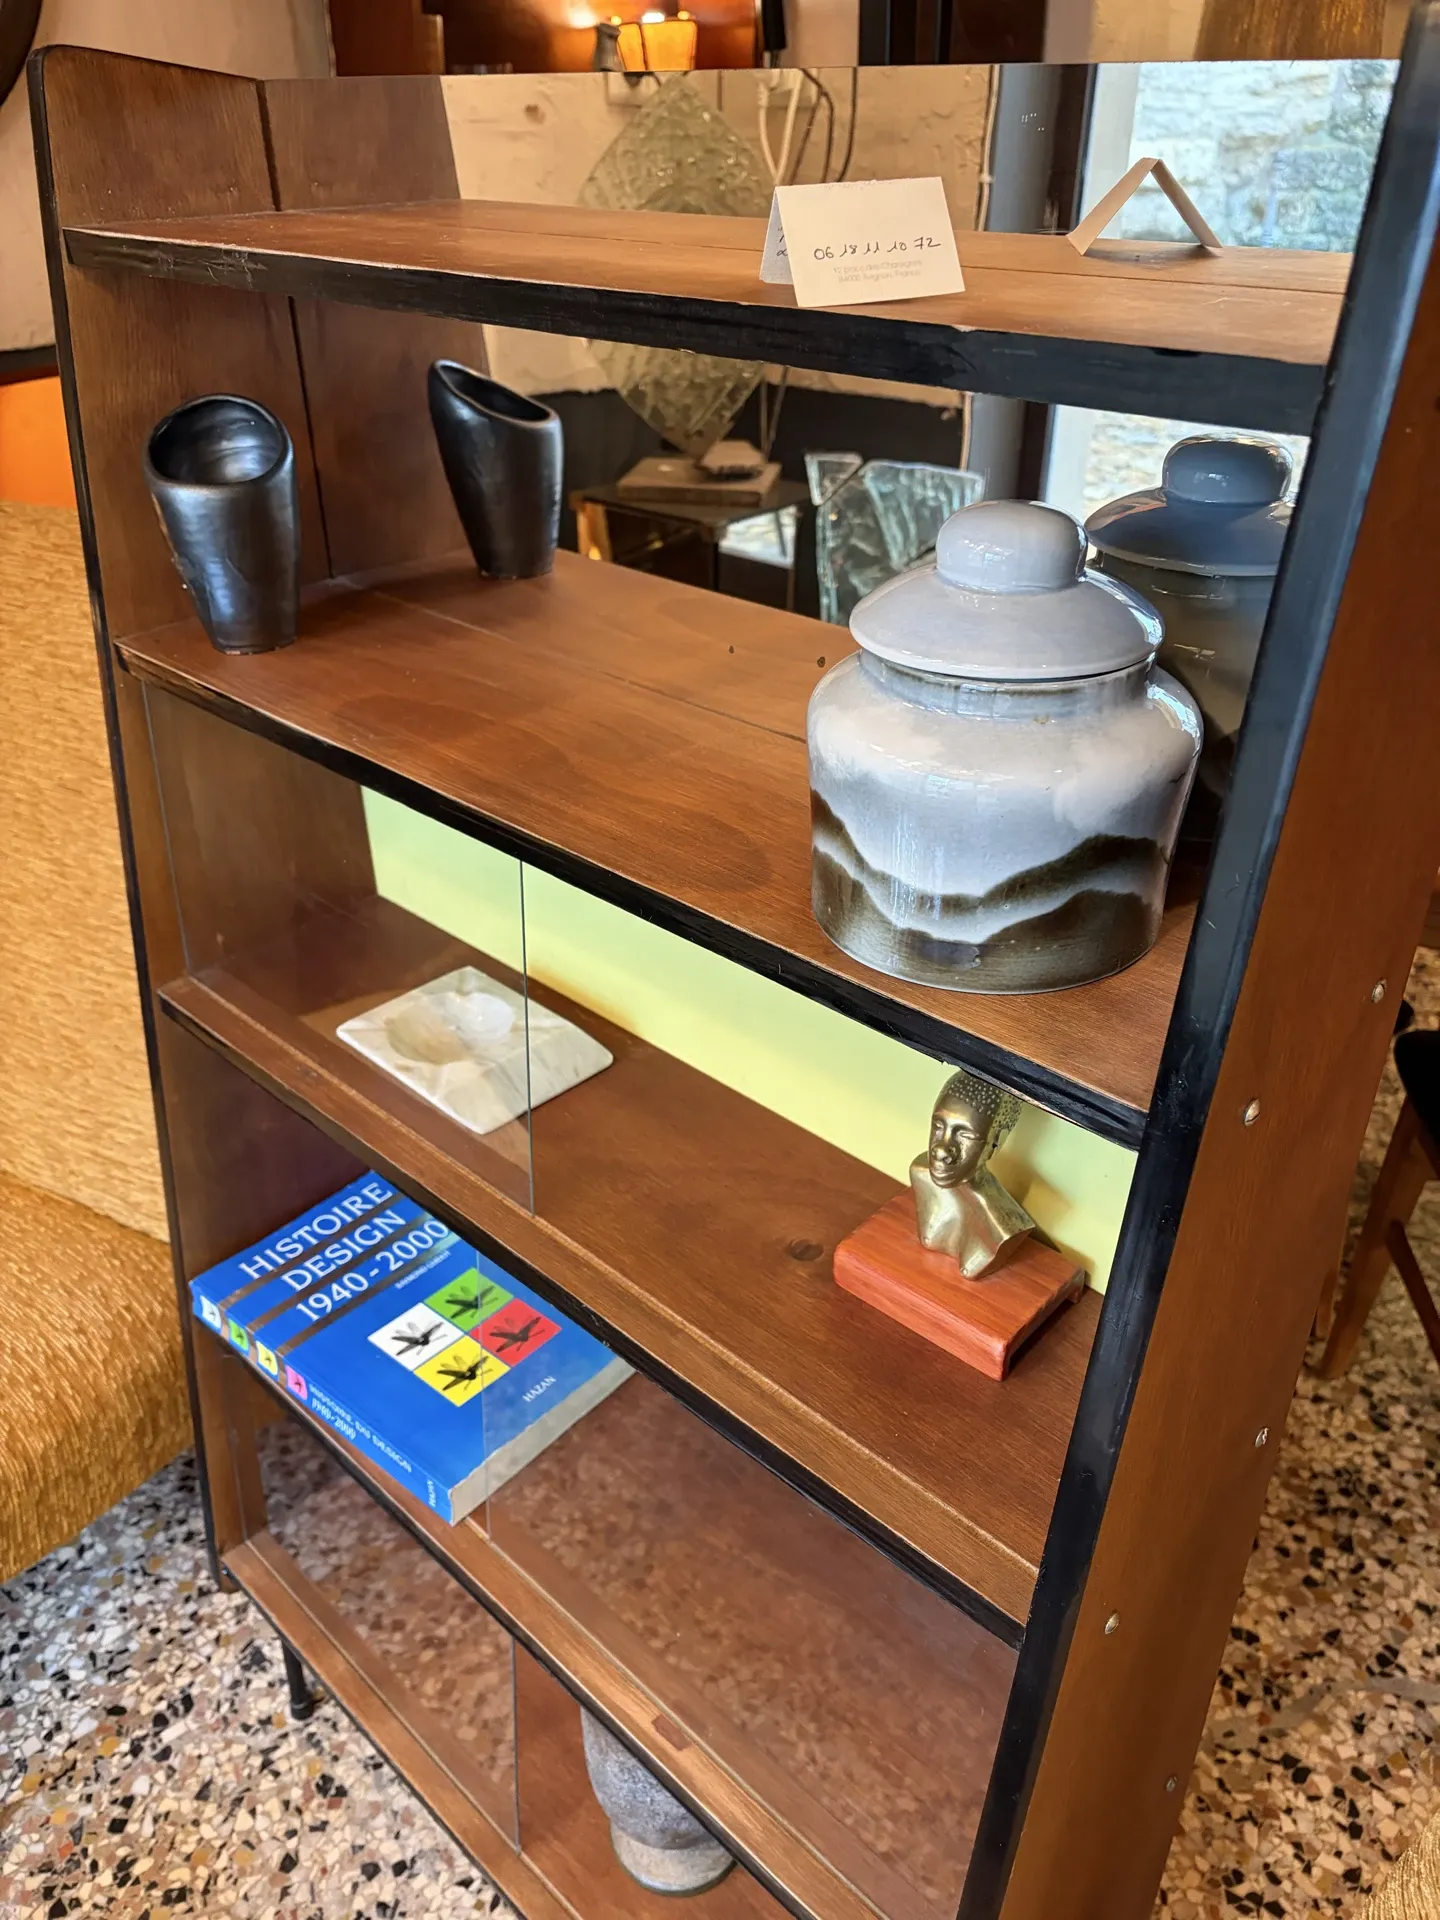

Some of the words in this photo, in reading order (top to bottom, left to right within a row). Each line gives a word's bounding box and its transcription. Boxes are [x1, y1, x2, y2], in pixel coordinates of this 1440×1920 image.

[814, 246, 834, 260] 06
[840, 244, 858, 257] 18
[863, 241, 880, 255] 11
[887, 241, 907, 253] 10
[913, 236, 941, 250] 72
[238, 1182, 393, 1280] HISTOIRE
[281, 1210, 406, 1292] DESIGN
[522, 1376, 556, 1402] HAZAN
